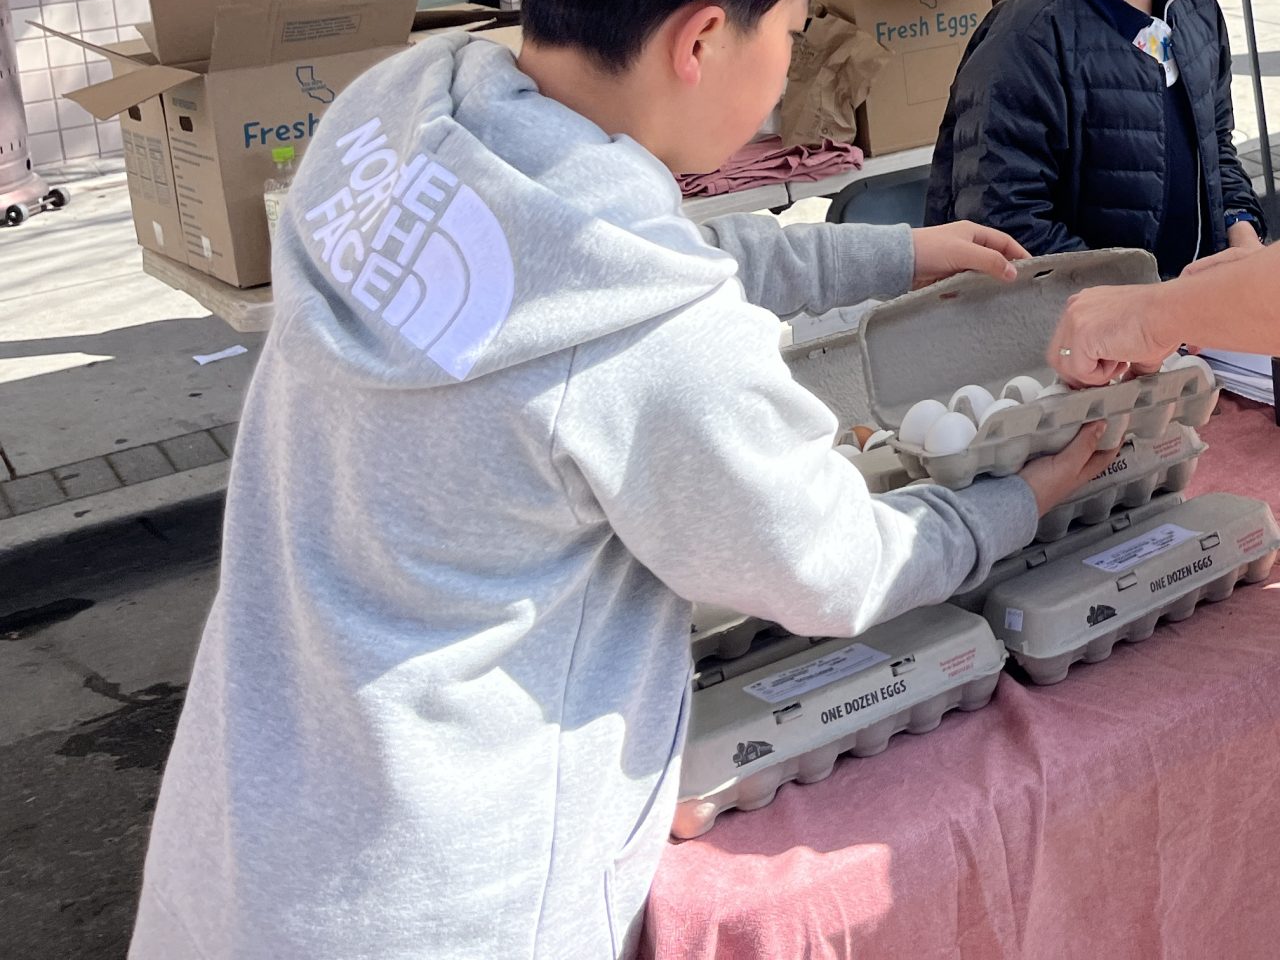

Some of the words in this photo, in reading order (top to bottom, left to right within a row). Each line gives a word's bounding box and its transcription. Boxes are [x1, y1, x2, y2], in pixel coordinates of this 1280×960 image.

[875, 15, 930, 42] Fresh
[936, 12, 978, 38] Eggs
[243, 112, 321, 149] Fresh
[304, 186, 402, 312] FACE
[1108, 459, 1128, 475] EGGS
[1149, 576, 1167, 593] ONE
[1166, 565, 1193, 586] DOZEN
[1193, 555, 1213, 573] EGGS
[820, 706, 844, 725] ONE
[845, 690, 879, 716] DOZEN
[881, 680, 907, 701] EGGS
